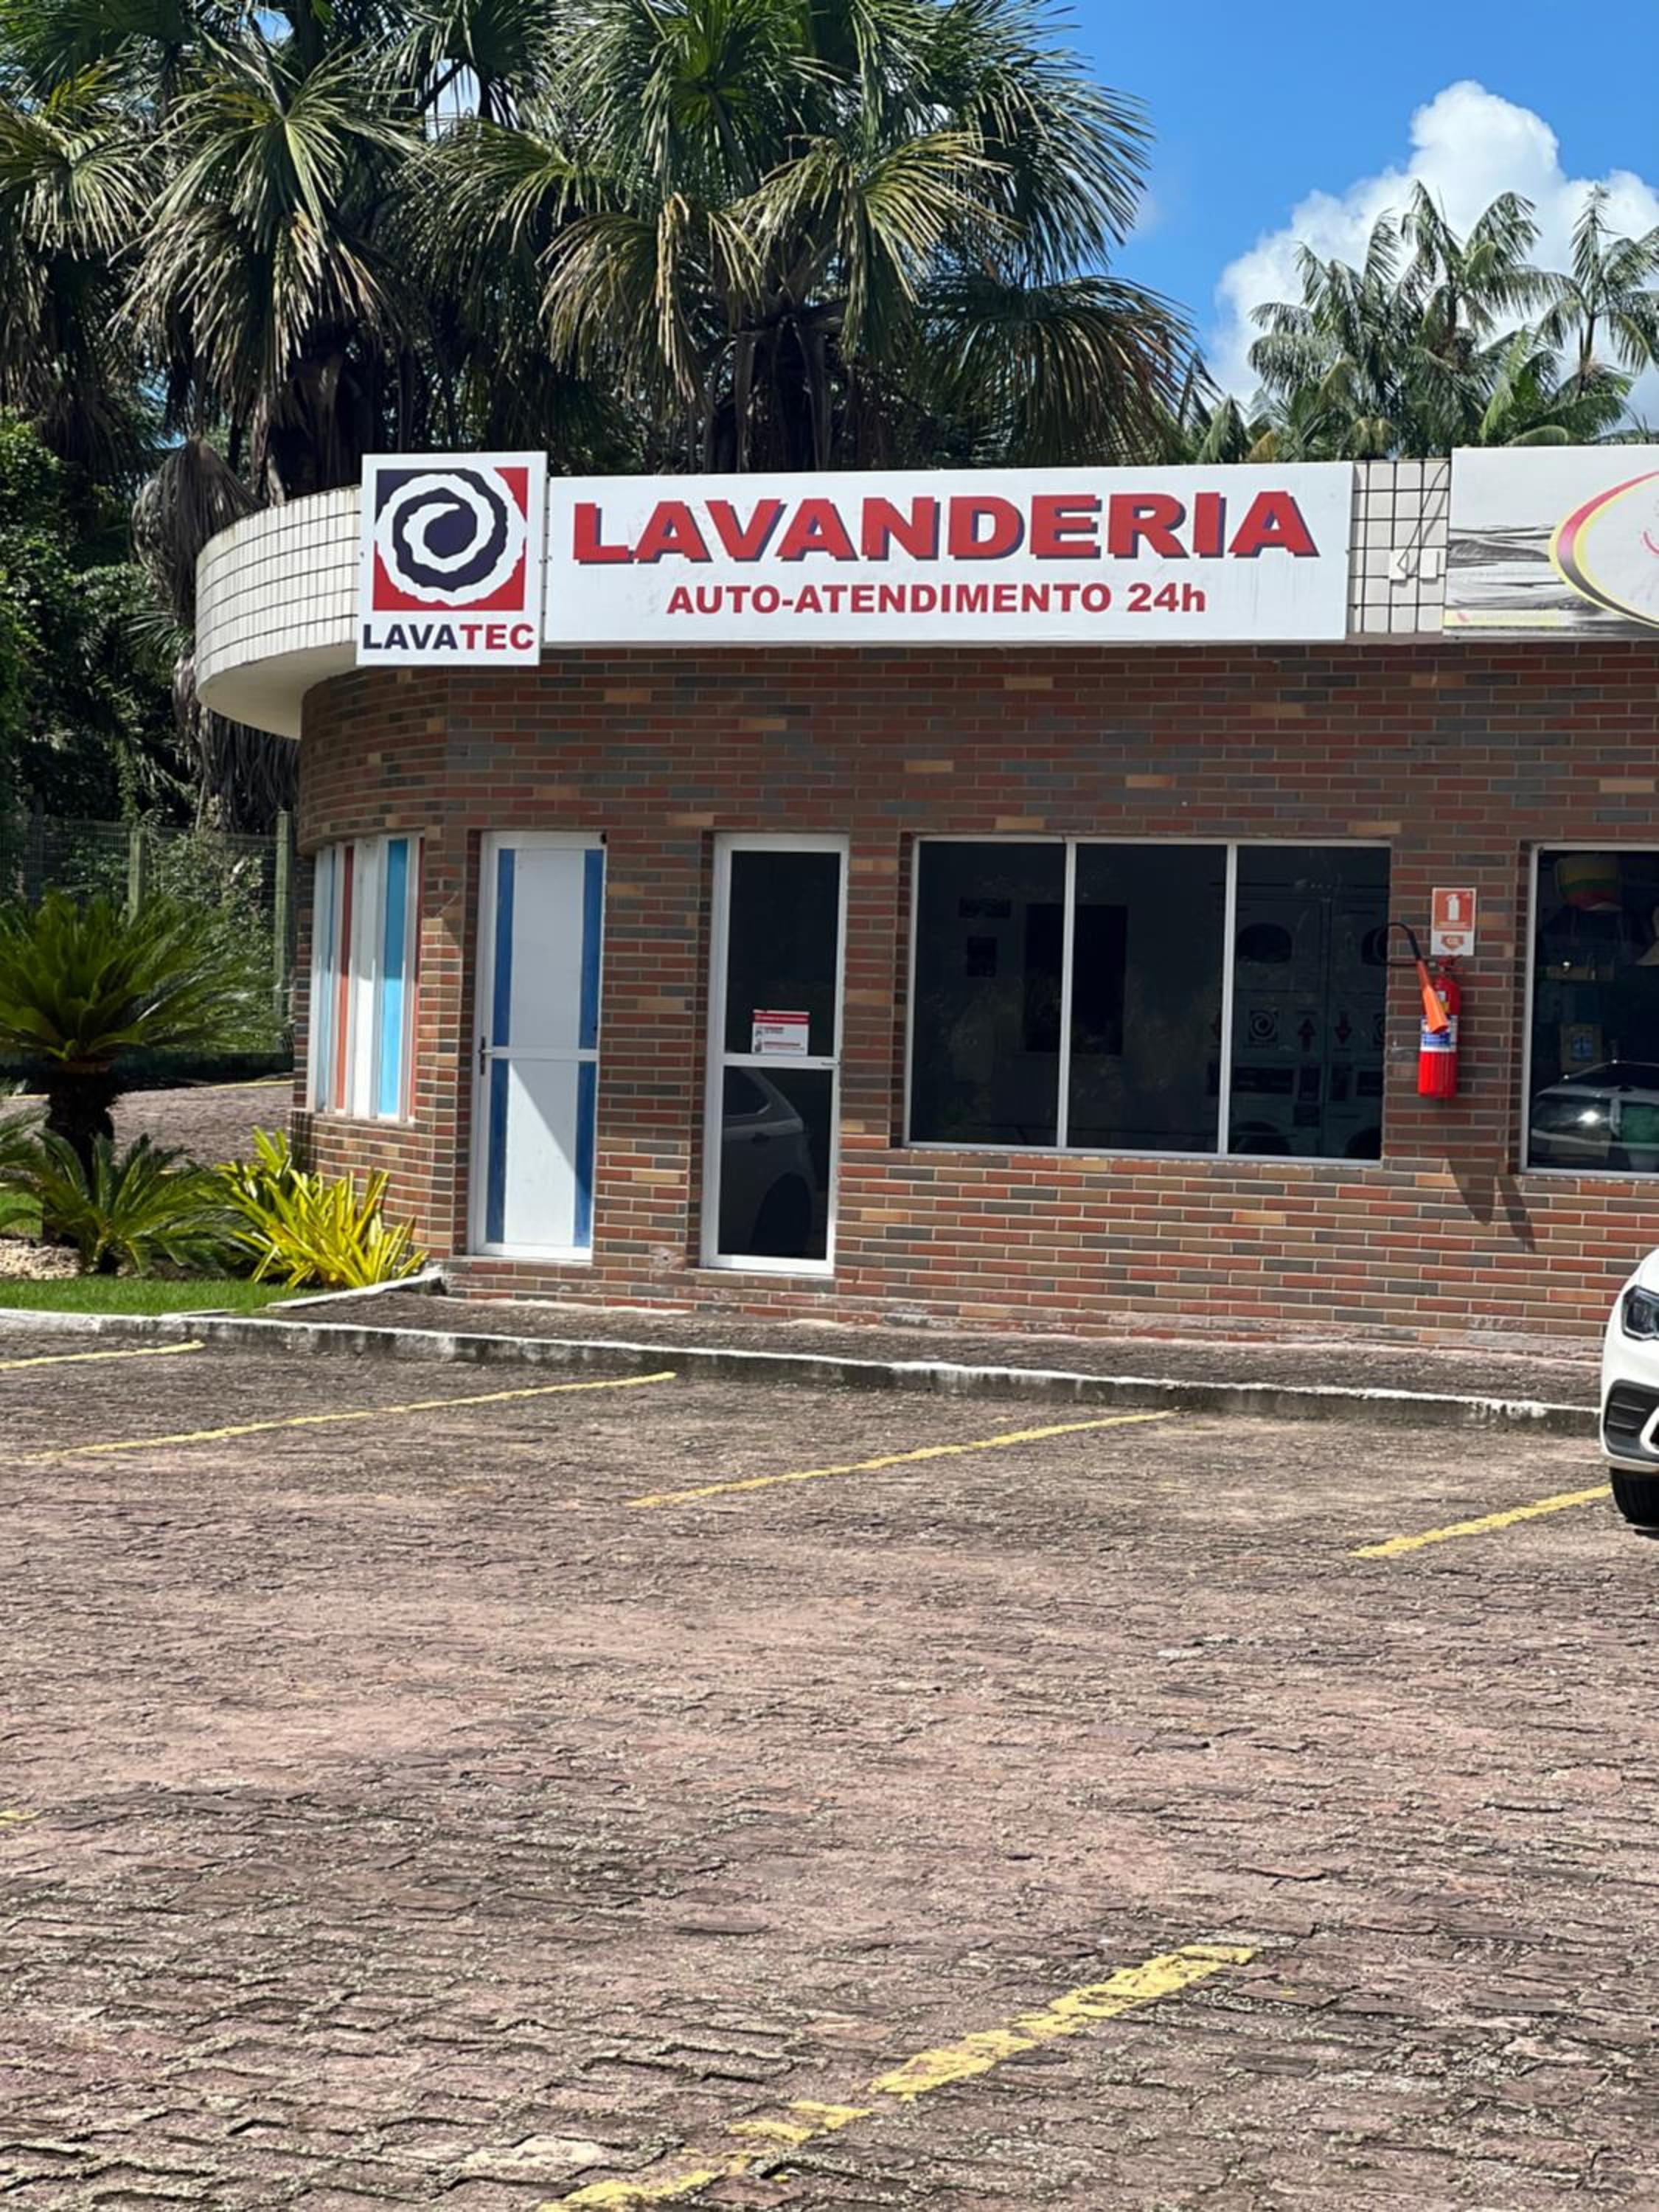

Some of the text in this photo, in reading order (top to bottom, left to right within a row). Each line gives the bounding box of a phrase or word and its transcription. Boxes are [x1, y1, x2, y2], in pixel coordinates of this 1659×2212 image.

[573, 491, 1321, 565] LAVANDERIA
[667, 582, 1206, 614] AUTO-ATENDIMENTO 24h
[363, 623, 535, 650] LAVATEC
